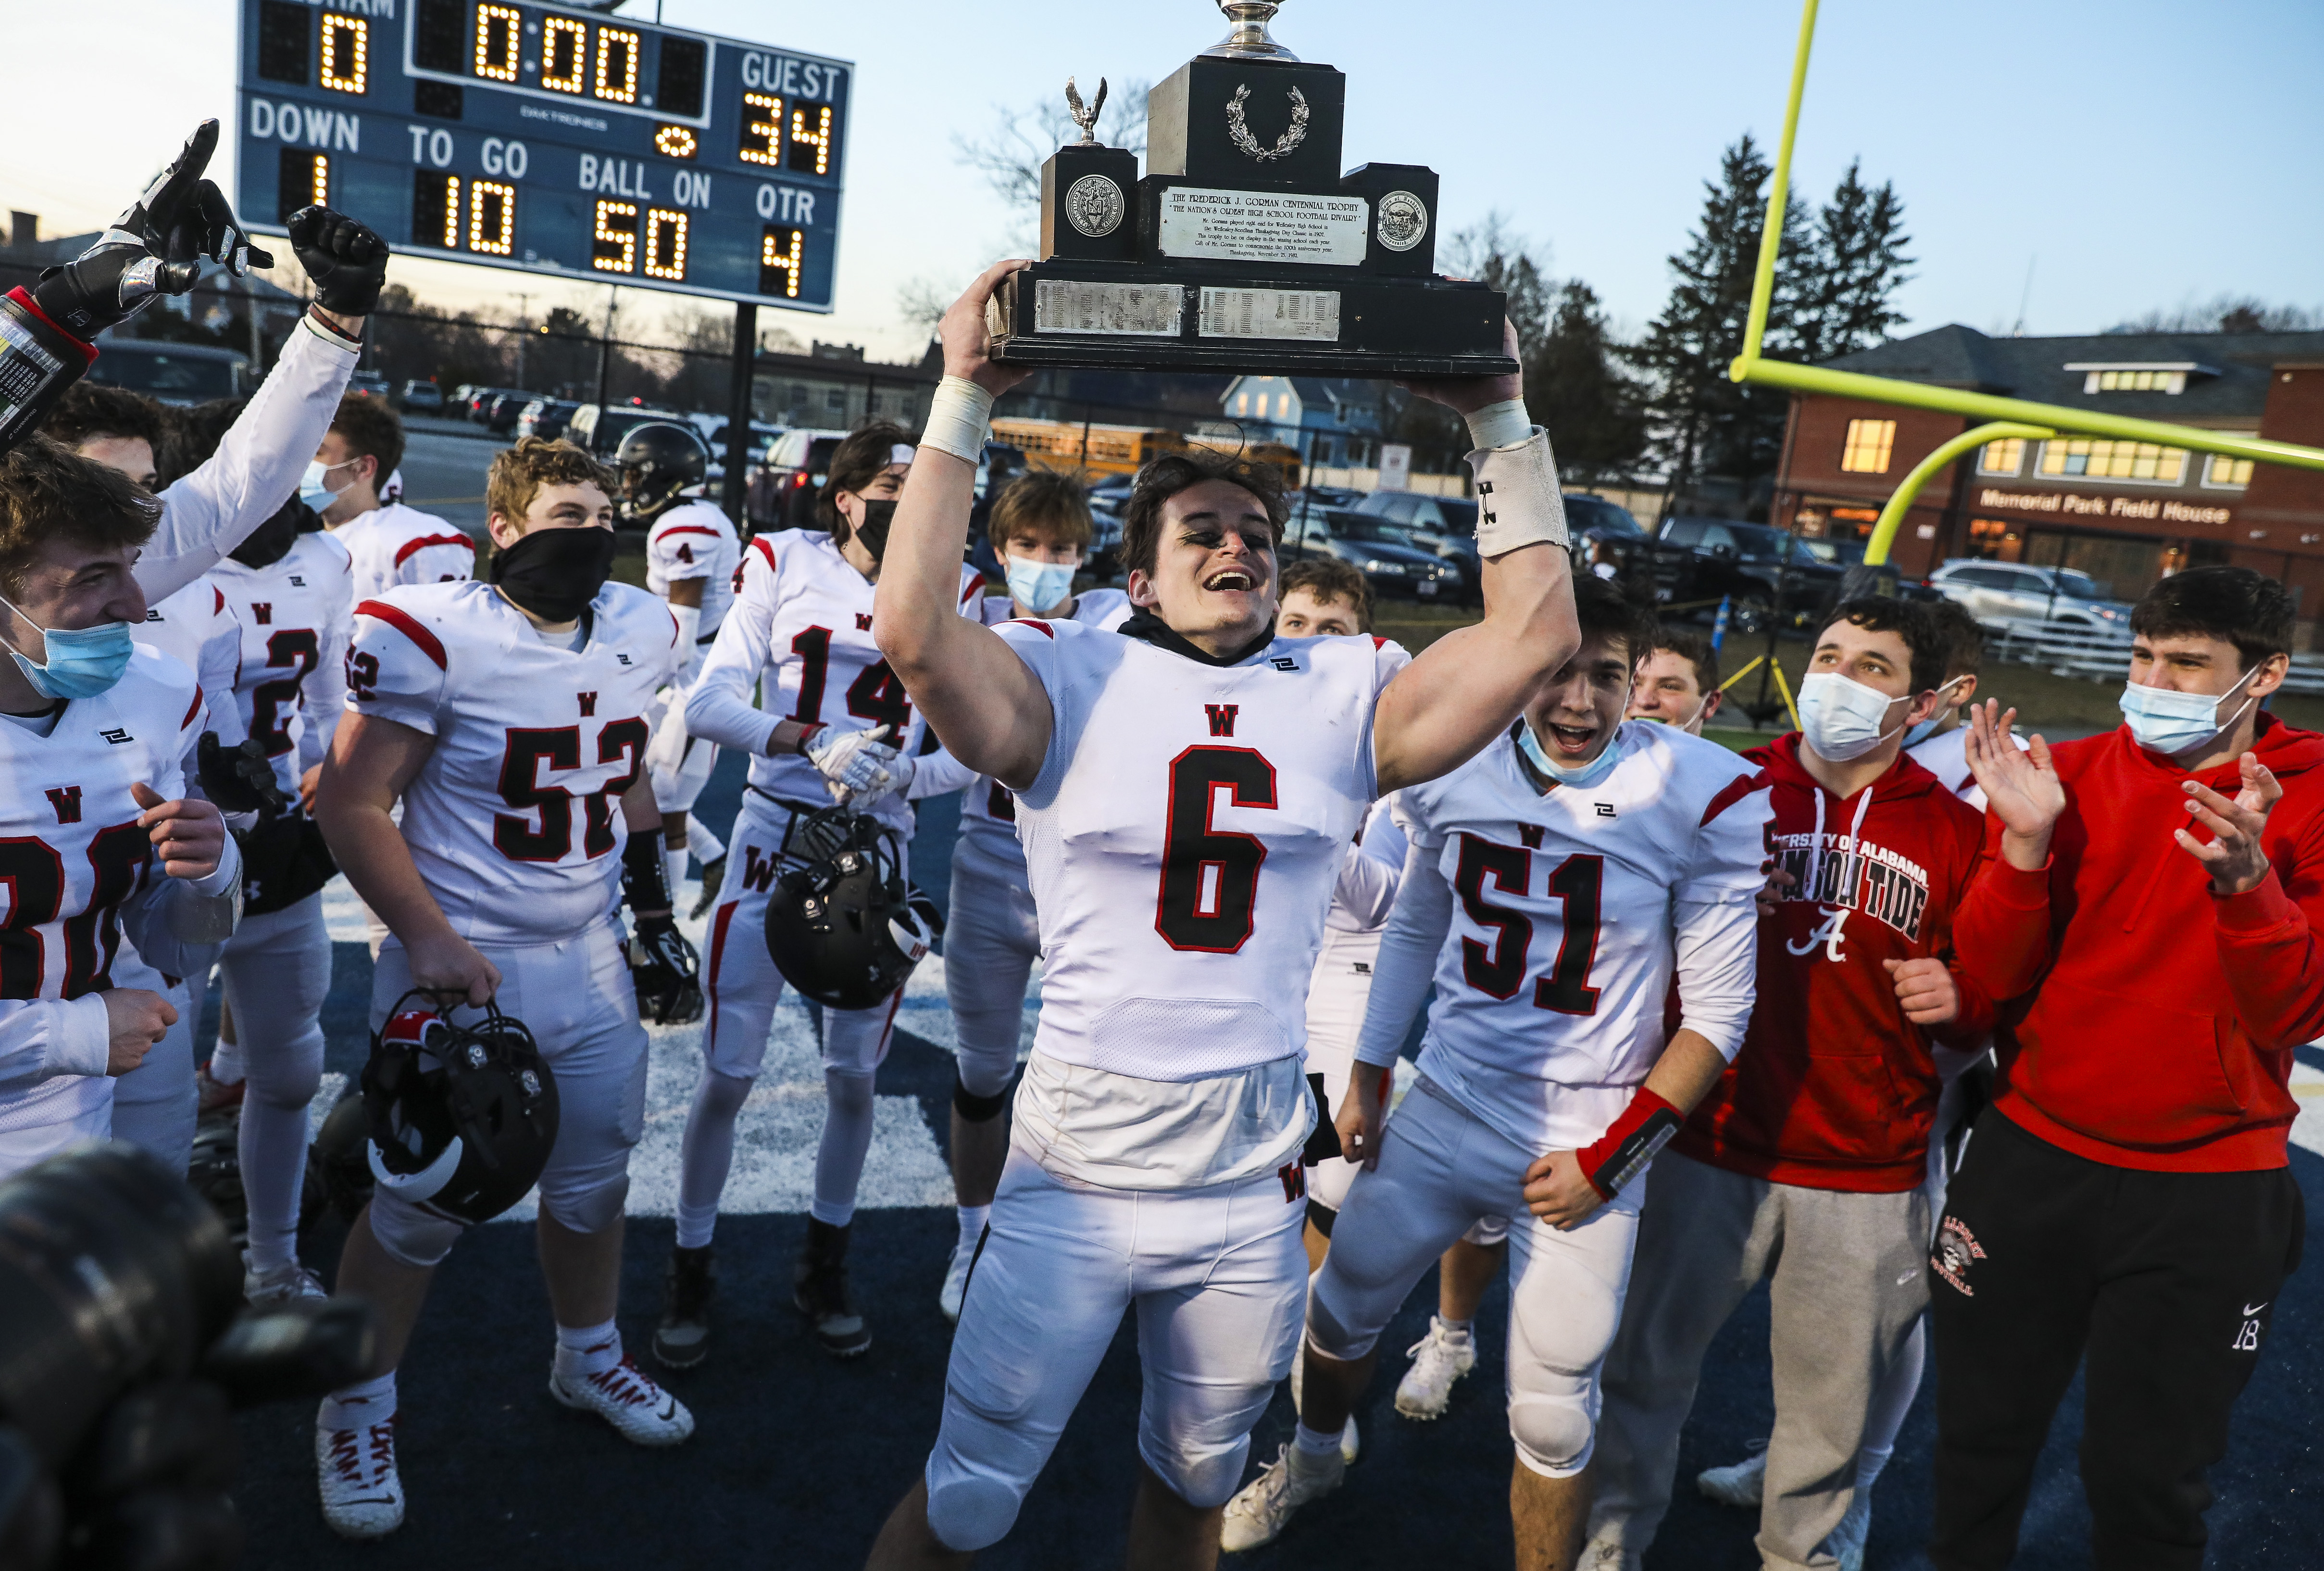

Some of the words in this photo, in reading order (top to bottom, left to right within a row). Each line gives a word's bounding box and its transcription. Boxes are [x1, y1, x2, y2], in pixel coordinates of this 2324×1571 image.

[321, 13, 367, 94] 0
[741, 51, 840, 103] GUEST
[250, 98, 360, 153] DOWN
[739, 92, 831, 175] 34
[408, 124, 454, 168] TO
[480, 137, 528, 179] GO
[313, 155, 328, 206] 1
[578, 153, 652, 200] BALL
[674, 169, 711, 210] ON
[756, 183, 815, 226] QTR
[1173, 193, 1185, 202] THE
[1189, 195, 1231, 204] FREDERICK
[1246, 198, 1279, 207] GORMAN
[1283, 200, 1324, 210] CENTENNIAL
[1327, 202, 1359, 211] TROPHY
[445, 176, 514, 255] 10
[1072, 191, 1089, 228] WELLESLEY
[1103, 212, 1117, 228] APRIL
[1380, 200, 1392, 212] Town
[1403, 196, 1421, 215] Needham
[593, 200, 688, 281] 50
[1410, 233, 1419, 242] 1711
[762, 230, 802, 298] 4
[13, 409, 37, 434] CHAMPRO
[1980, 489, 2062, 512] Memorial
[2063, 494, 2106, 515] Park
[2111, 497, 2161, 519] Field
[2162, 500, 2231, 525] House
[676, 542, 694, 564] 4
[251, 603, 272, 625] W
[855, 612, 873, 632] W
[577, 691, 598, 717] W
[785, 625, 912, 751] 14
[1204, 704, 1238, 737] W
[45, 785, 82, 824] W
[494, 716, 649, 863] 52
[1155, 744, 1278, 954] 6
[1517, 822, 1546, 851] W
[742, 844, 786, 893] W
[1860, 841, 1929, 888] ALABAMA
[1455, 830, 1604, 1016] 51
[1865, 858, 1929, 944] TIDE
[1786, 906, 1851, 962] A
[1277, 1151, 1305, 1204] W
[1943, 1215, 1988, 1259] LLESLEY
[2232, 1319, 2261, 1350] 18
